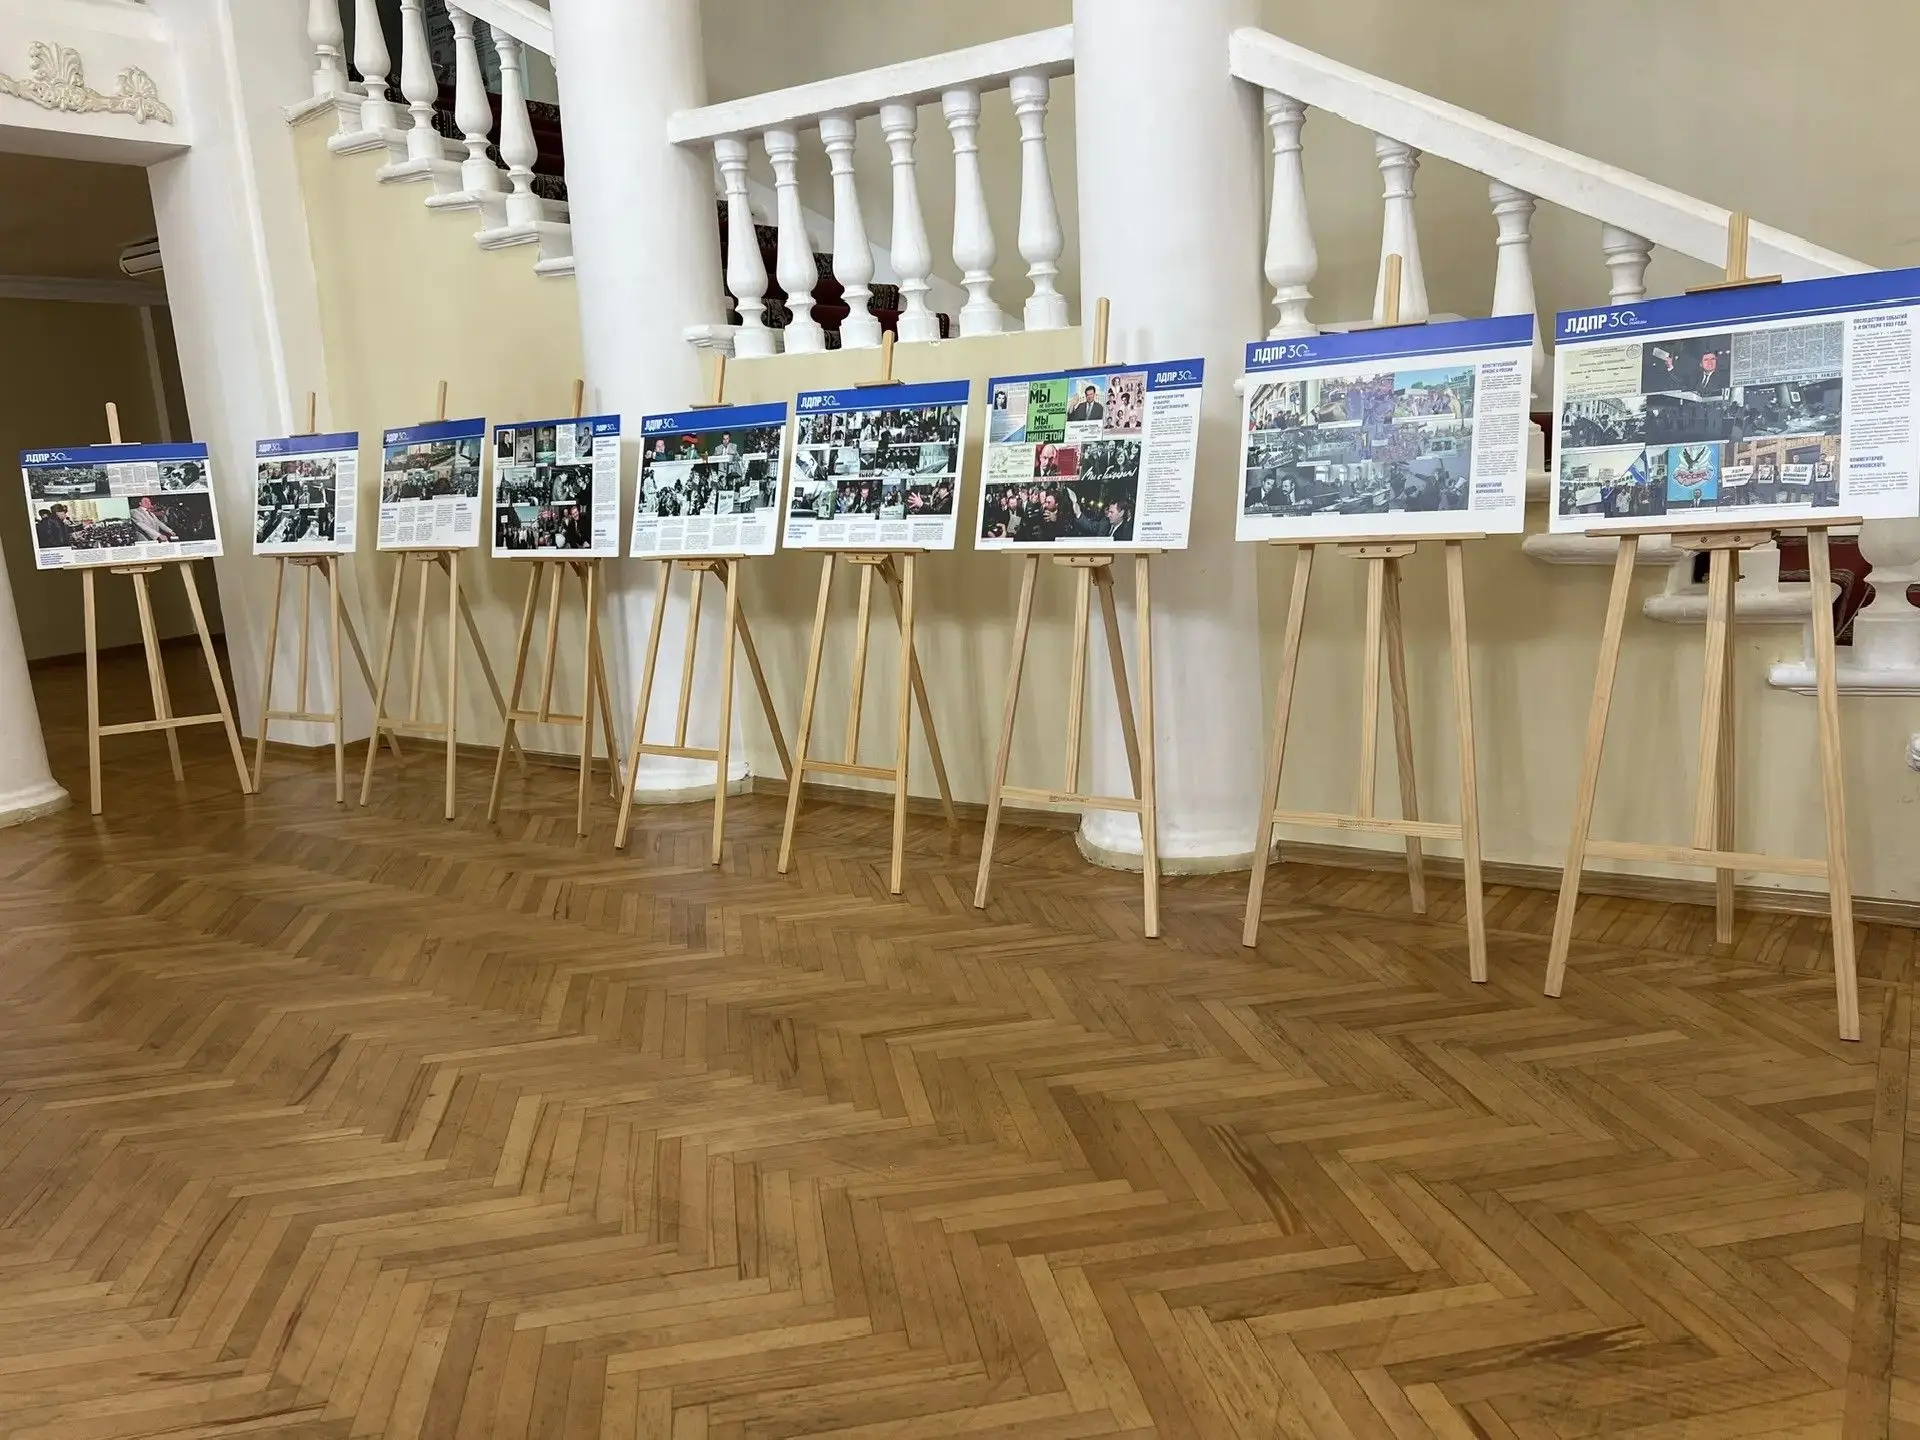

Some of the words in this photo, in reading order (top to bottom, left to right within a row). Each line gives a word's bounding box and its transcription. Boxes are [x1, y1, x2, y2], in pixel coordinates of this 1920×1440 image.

[1564, 314, 1607, 334] ЛДПР
[1253, 346, 1287, 364] ЛДПР
[1155, 371, 1177, 384] ЛДПР
[801, 396, 822, 409] ЛДПР
[1030, 389, 1050, 405] МЫ
[645, 419, 662, 431] ЛДПР
[1034, 415, 1049, 425] МЫ
[25, 453, 49, 463] ЛДПР
